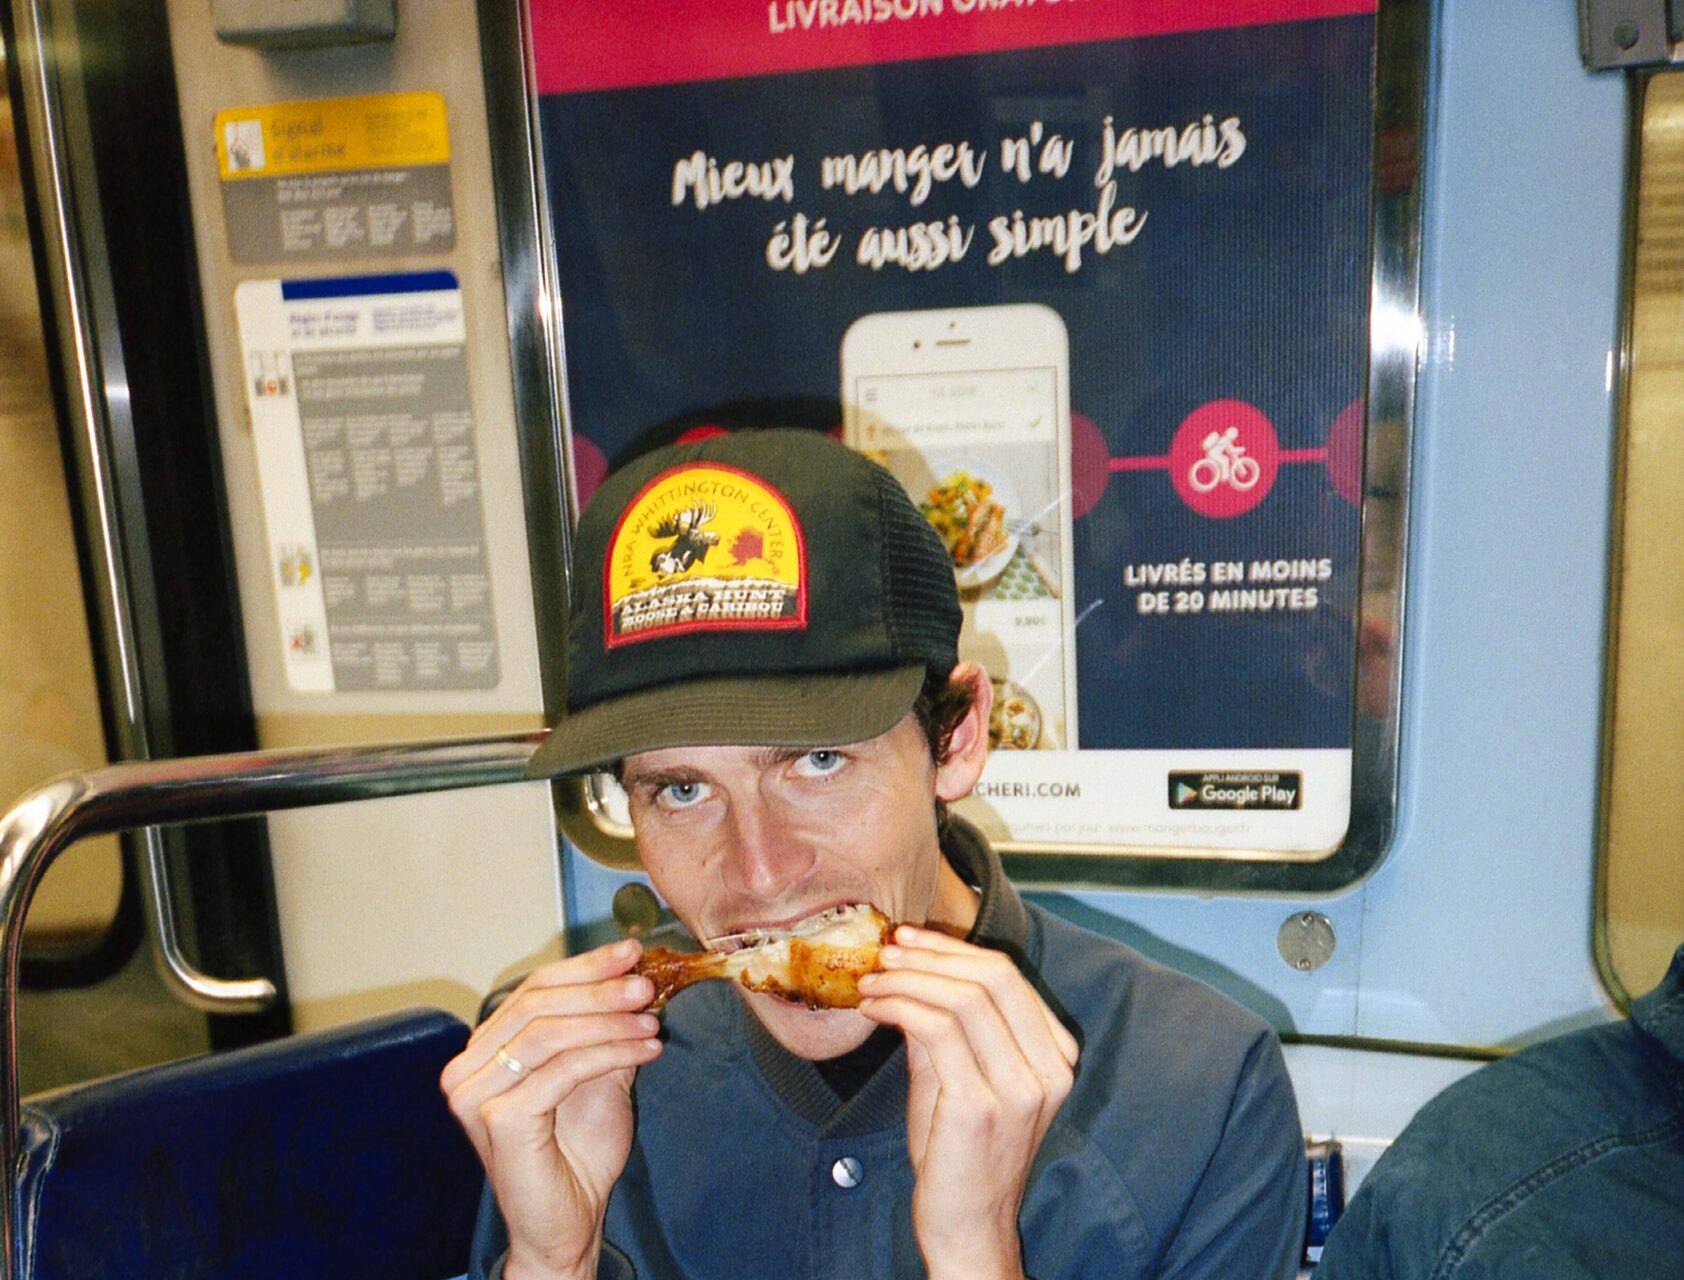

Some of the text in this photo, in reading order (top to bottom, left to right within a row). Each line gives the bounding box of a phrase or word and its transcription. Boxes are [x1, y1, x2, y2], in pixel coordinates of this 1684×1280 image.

[671, 113, 1247, 210] Mieux manger n'a jamais
[765, 179, 1149, 274] été aussi simple
[633, 480, 749, 535] WHITTINGTON
[750, 502, 784, 559] CENTER
[1125, 557, 1333, 586] LIVRÉS EN MOINS
[622, 589, 786, 616] ALASKA HUNT
[622, 607, 678, 627] MOOSE
[697, 602, 784, 615] CARIBOU
[1138, 587, 1319, 614] DE 20 MINUTES
[971, 782, 1081, 798] CHERI.COM
[1202, 784, 1297, 807] Google Play
